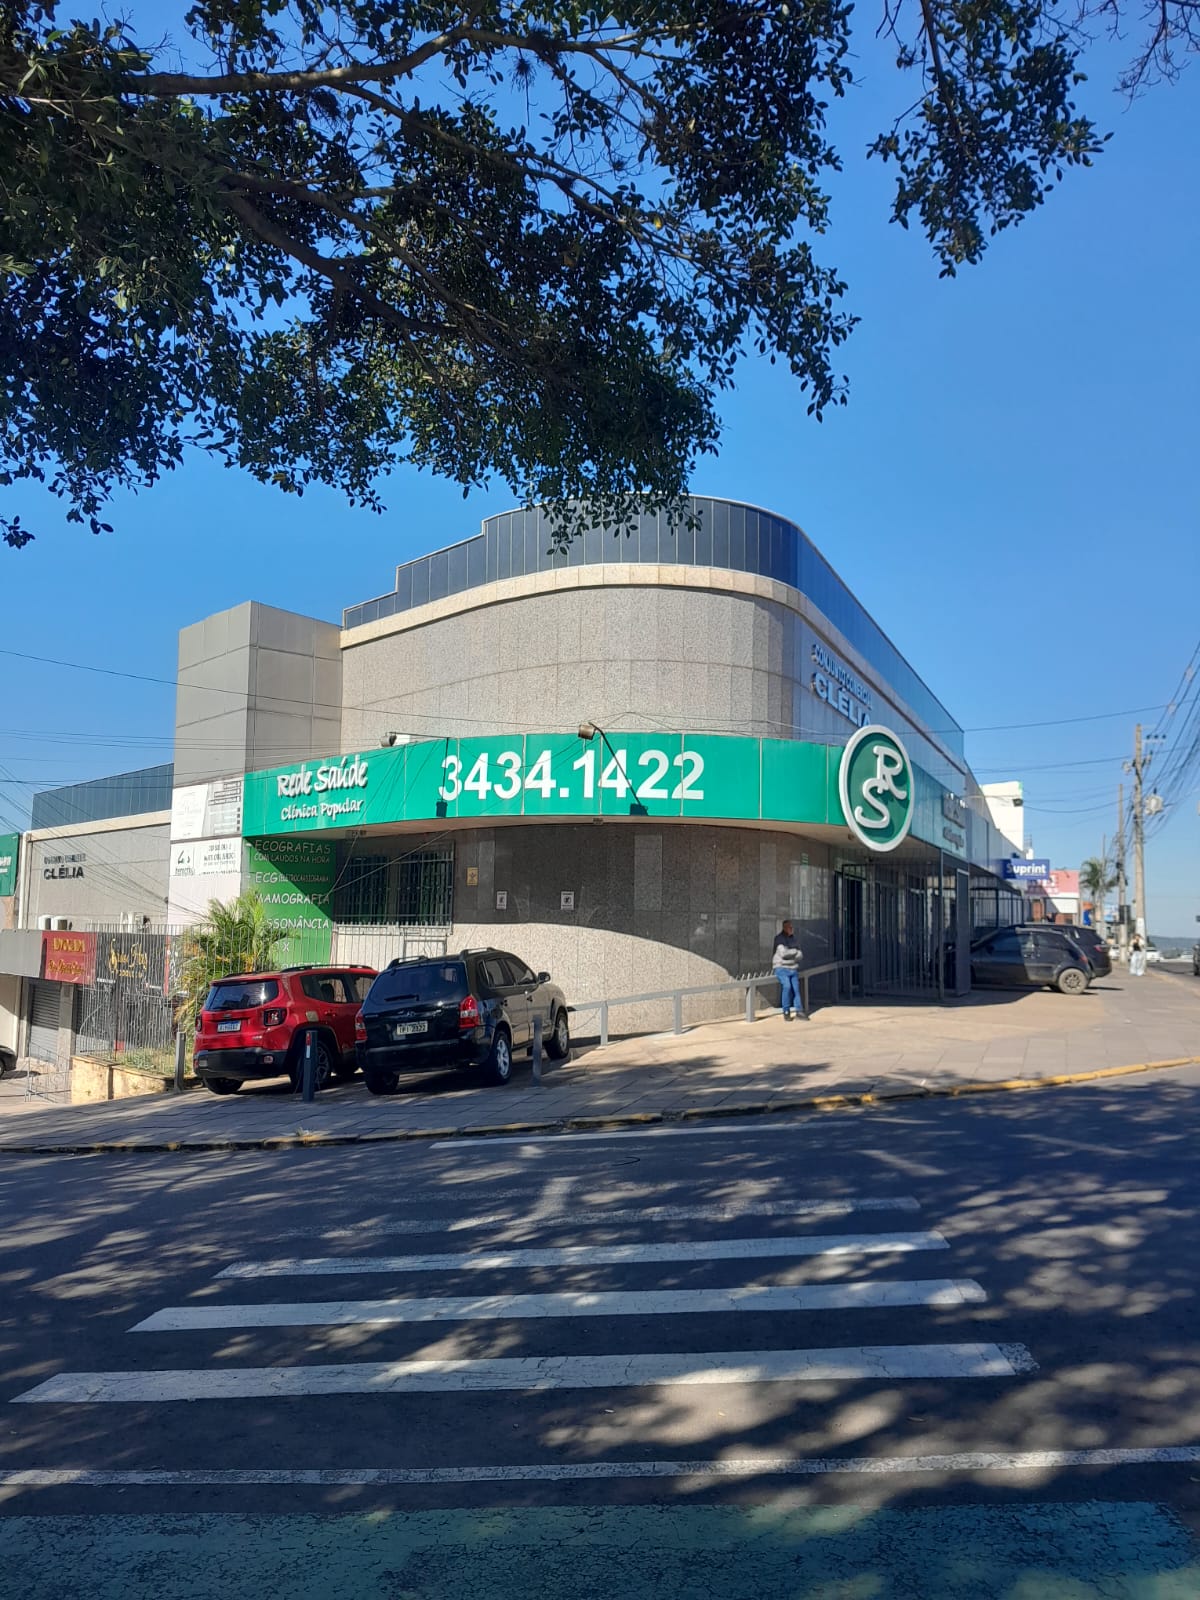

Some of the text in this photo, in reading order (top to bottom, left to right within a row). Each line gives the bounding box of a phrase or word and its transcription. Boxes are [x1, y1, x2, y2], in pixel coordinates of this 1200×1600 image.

[812, 671, 871, 728] CLÉLIA
[277, 754, 368, 797] Rede Saúde
[438, 749, 705, 801] 3434.1422
[281, 798, 364, 822] Clínica Popular
[255, 840, 331, 855] ECOGRAFIAS
[44, 864, 85, 880] CLÉLIA
[255, 872, 278, 883] ECG
[254, 892, 330, 906] MAMOGRAFIA
[262, 915, 330, 929] SSONÂNCIA
